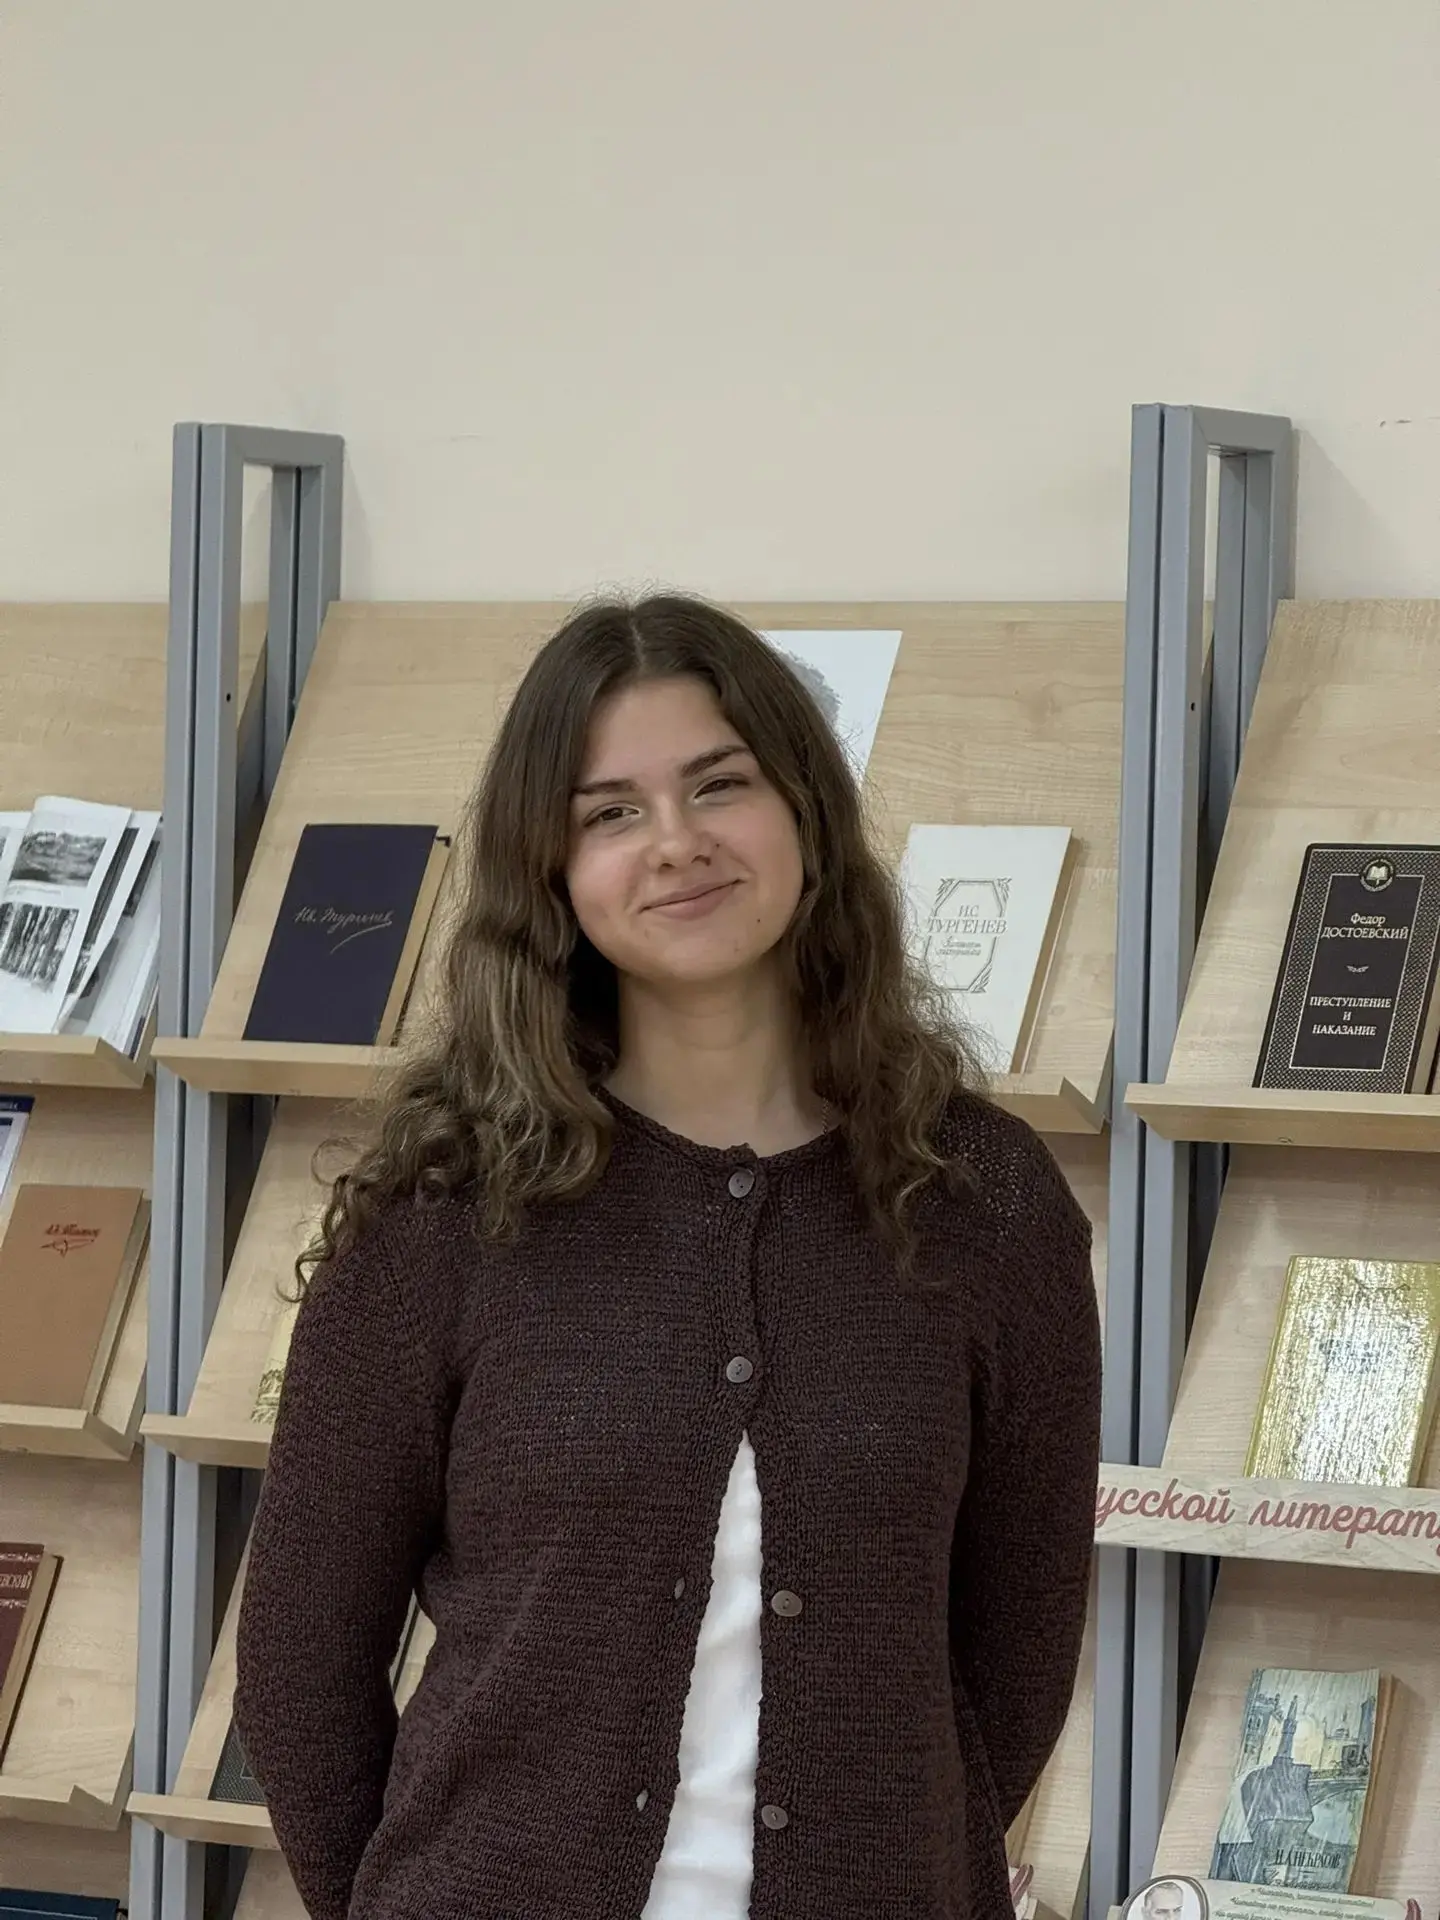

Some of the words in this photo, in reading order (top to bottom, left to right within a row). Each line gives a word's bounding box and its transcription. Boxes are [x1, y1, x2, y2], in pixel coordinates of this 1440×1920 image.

[927, 918, 1008, 934] ТУРГЕНЕВ
[1350, 912, 1387, 928] Федор
[1320, 926, 1410, 940] ДОСТОЕВСКИЙ
[1309, 995, 1392, 1009] ПРЕСТУПЛЕНИЕ
[1342, 1011, 1353, 1022] И
[1311, 1023, 1378, 1037] НАКАЗАНИЕ
[1095, 1477, 1236, 1529] усской
